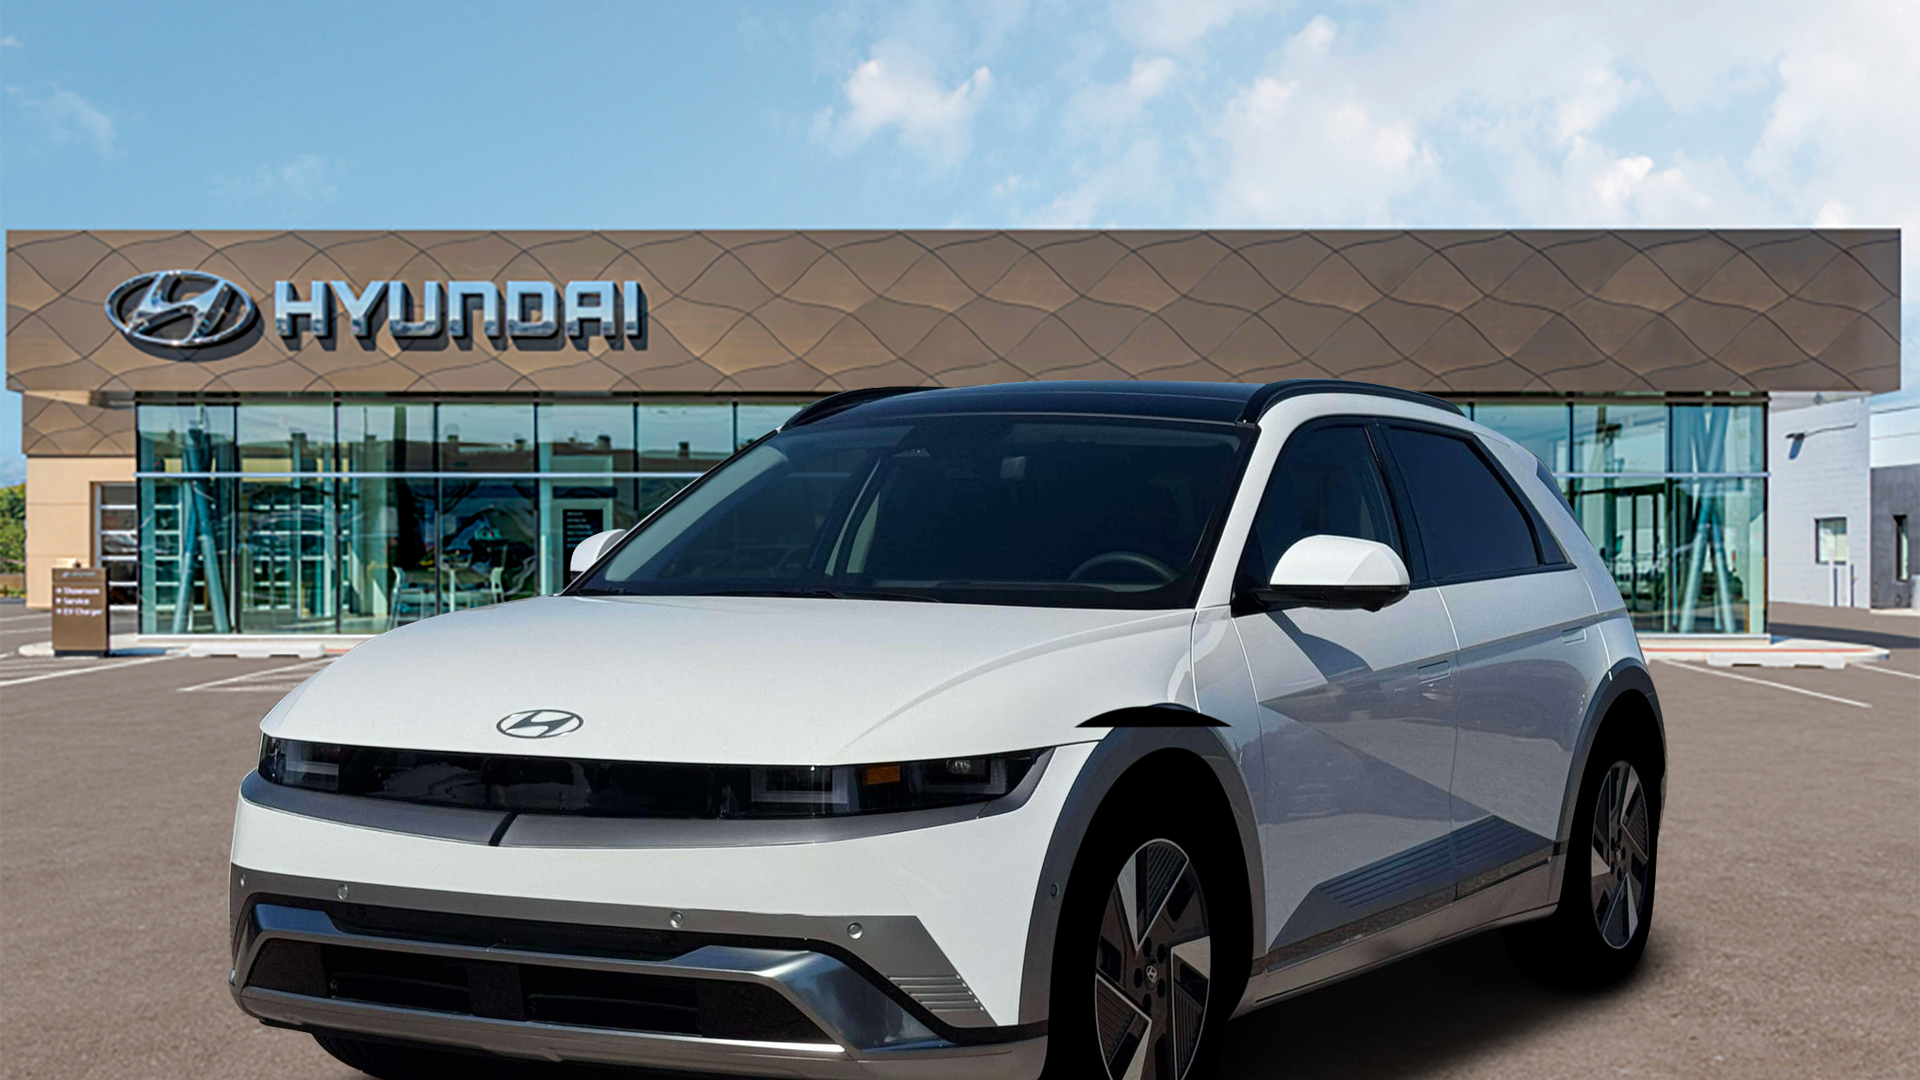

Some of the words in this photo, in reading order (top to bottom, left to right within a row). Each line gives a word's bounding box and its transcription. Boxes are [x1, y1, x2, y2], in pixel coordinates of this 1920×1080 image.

[274, 280, 645, 341] HYUNDAI
[63, 587, 100, 595] Showroom
[63, 597, 90, 605] Service
